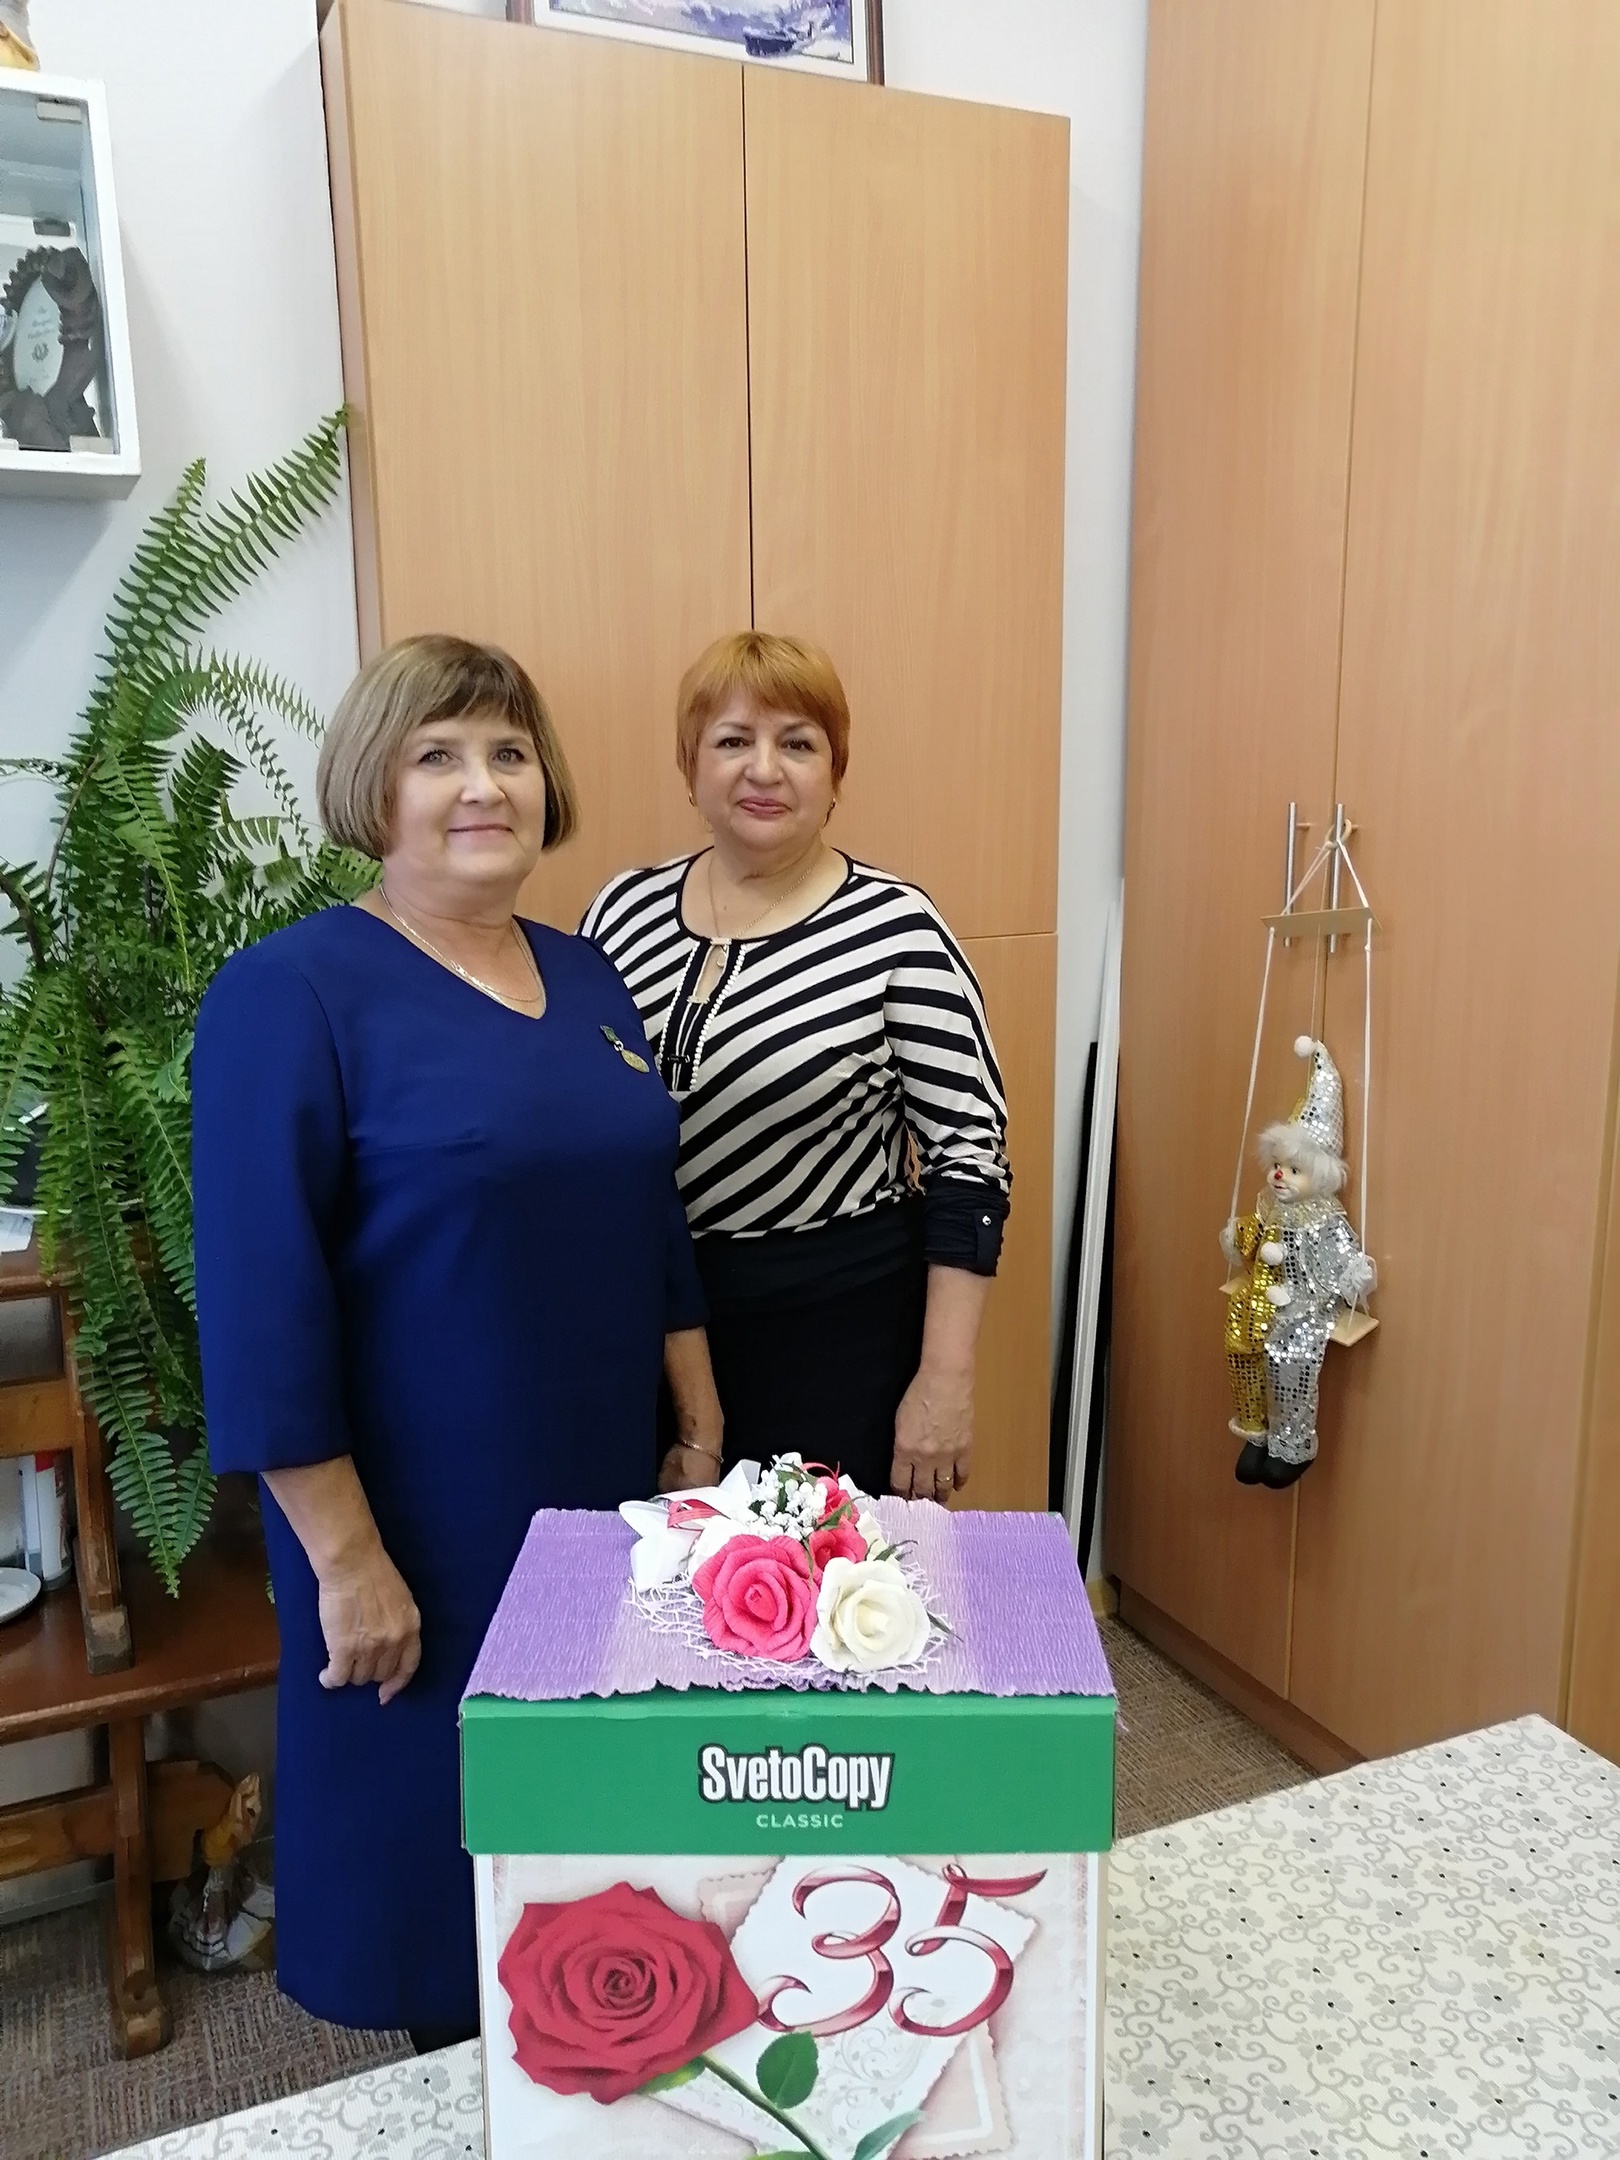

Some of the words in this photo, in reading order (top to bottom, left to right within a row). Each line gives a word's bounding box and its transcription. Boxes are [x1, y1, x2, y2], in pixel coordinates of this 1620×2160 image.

[699, 1744, 894, 1811] SvetoCopy
[756, 1814, 844, 1829] CLASSIC
[757, 1864, 1048, 2037] 35
